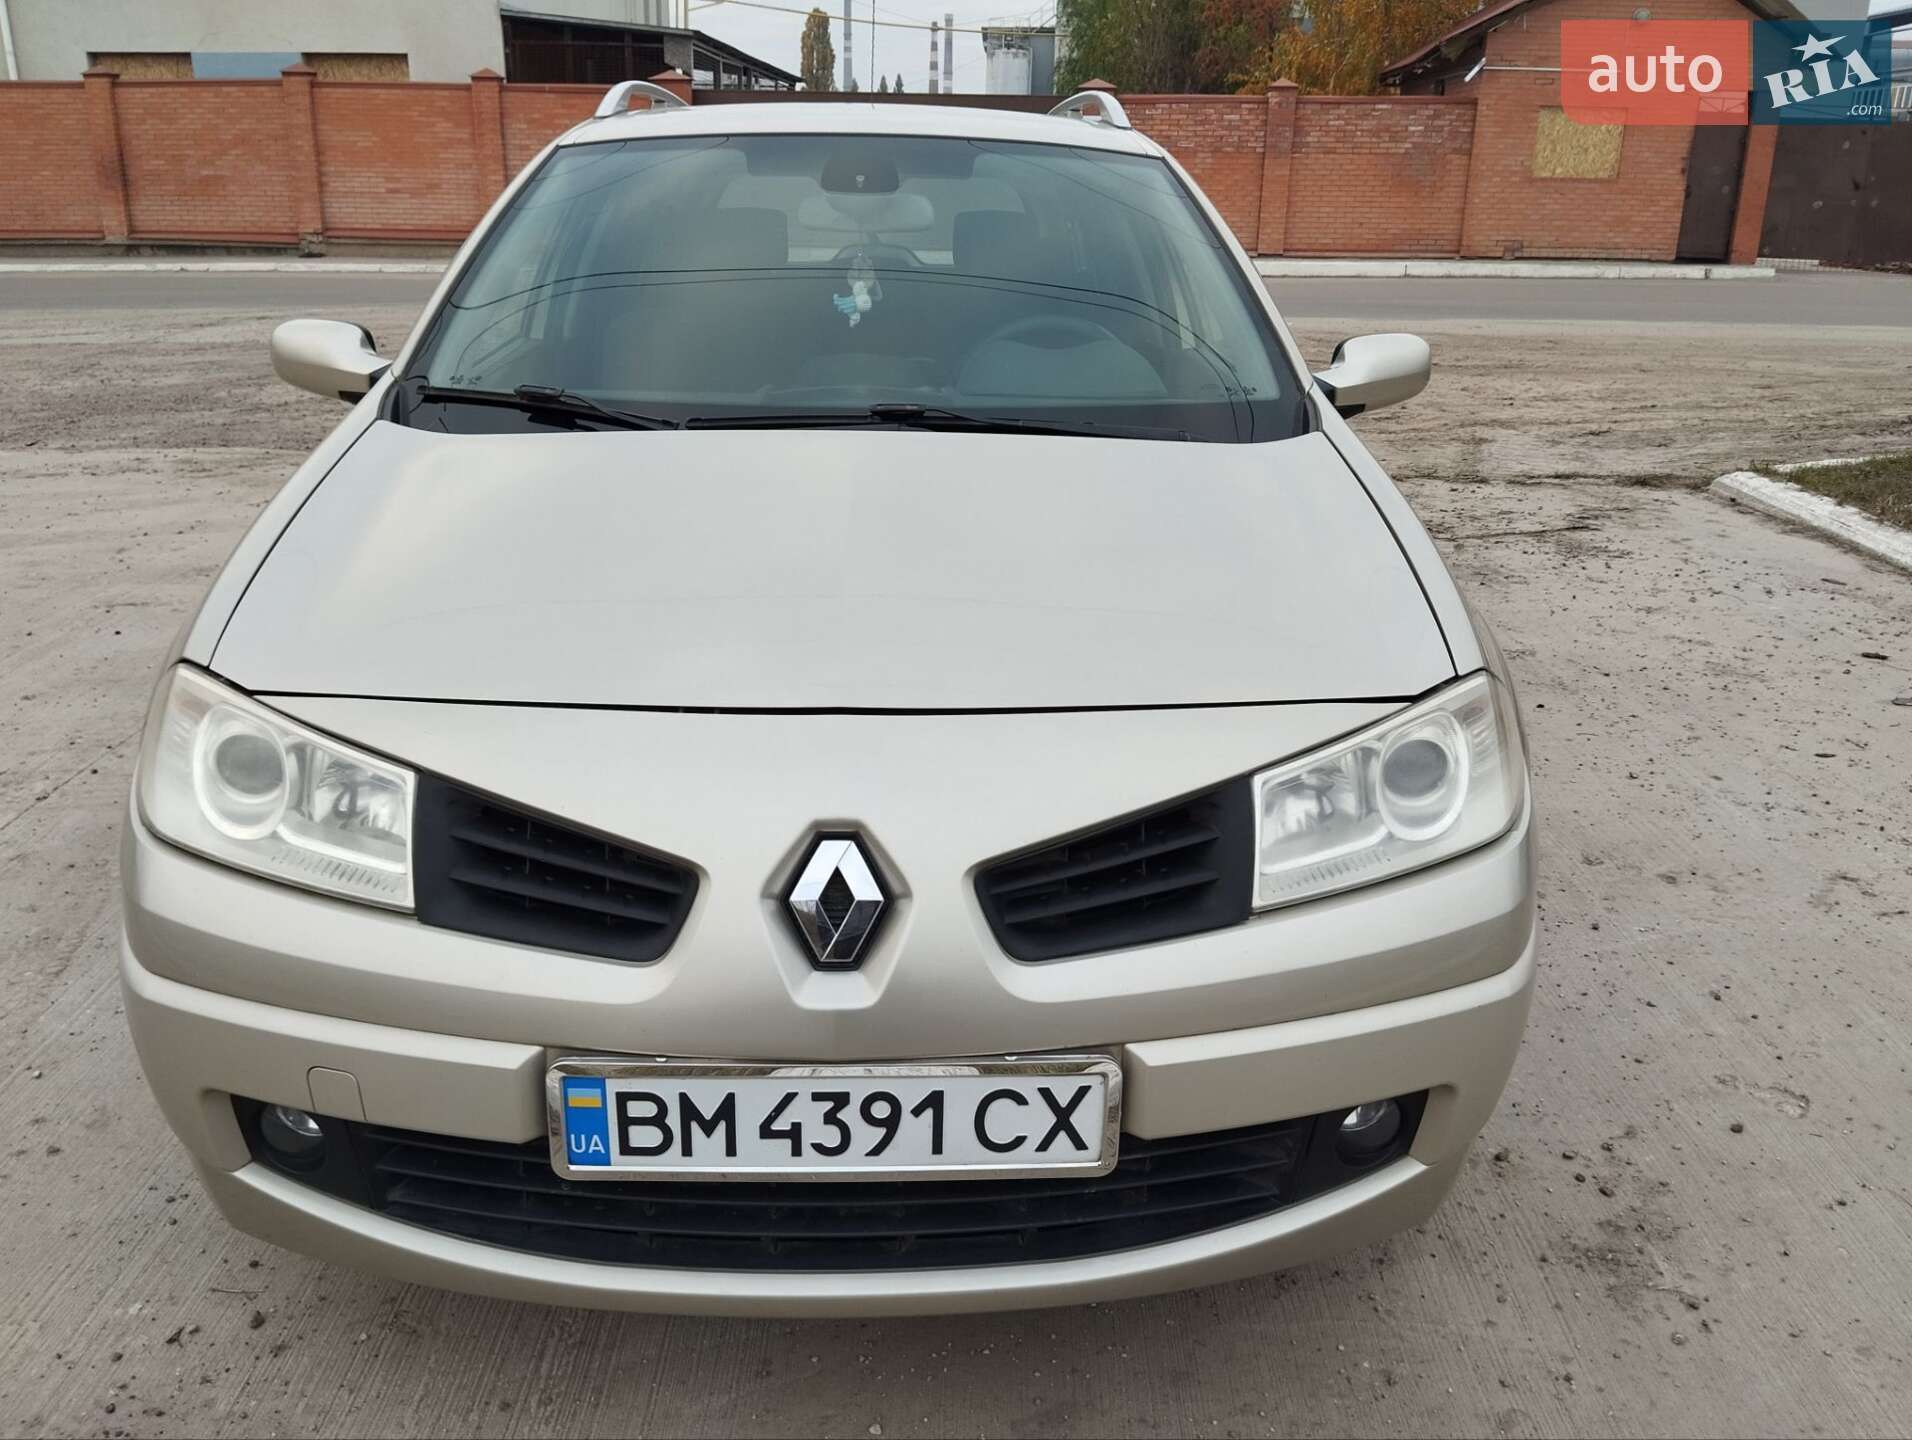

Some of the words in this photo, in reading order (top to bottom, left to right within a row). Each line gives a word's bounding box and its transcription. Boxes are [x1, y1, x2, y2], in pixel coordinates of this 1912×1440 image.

[570, 1133, 606, 1155] UA
[615, 1091, 736, 1158] BM
[758, 1089, 944, 1158] 4391
[973, 1085, 1093, 1154] CX
